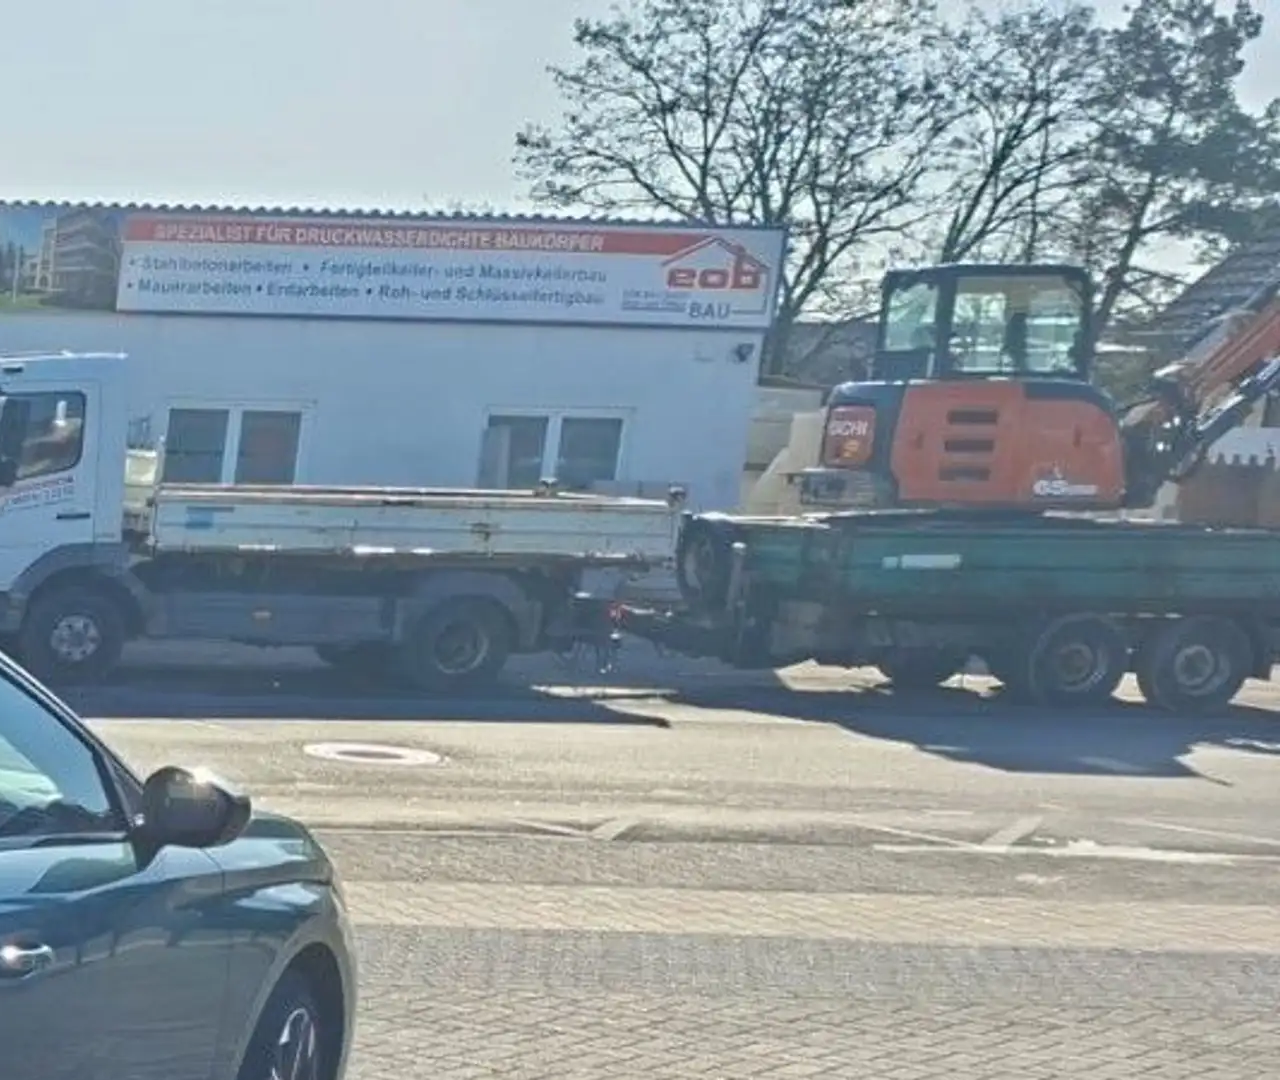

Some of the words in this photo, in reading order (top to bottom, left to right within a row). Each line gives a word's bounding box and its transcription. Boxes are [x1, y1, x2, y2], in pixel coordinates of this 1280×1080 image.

[154, 224, 254, 242] SPEZIALIST
[256, 223, 291, 242] FÜR
[444, 264, 475, 279] und
[666, 246, 760, 290] eob
[689, 301, 731, 319] BAU
